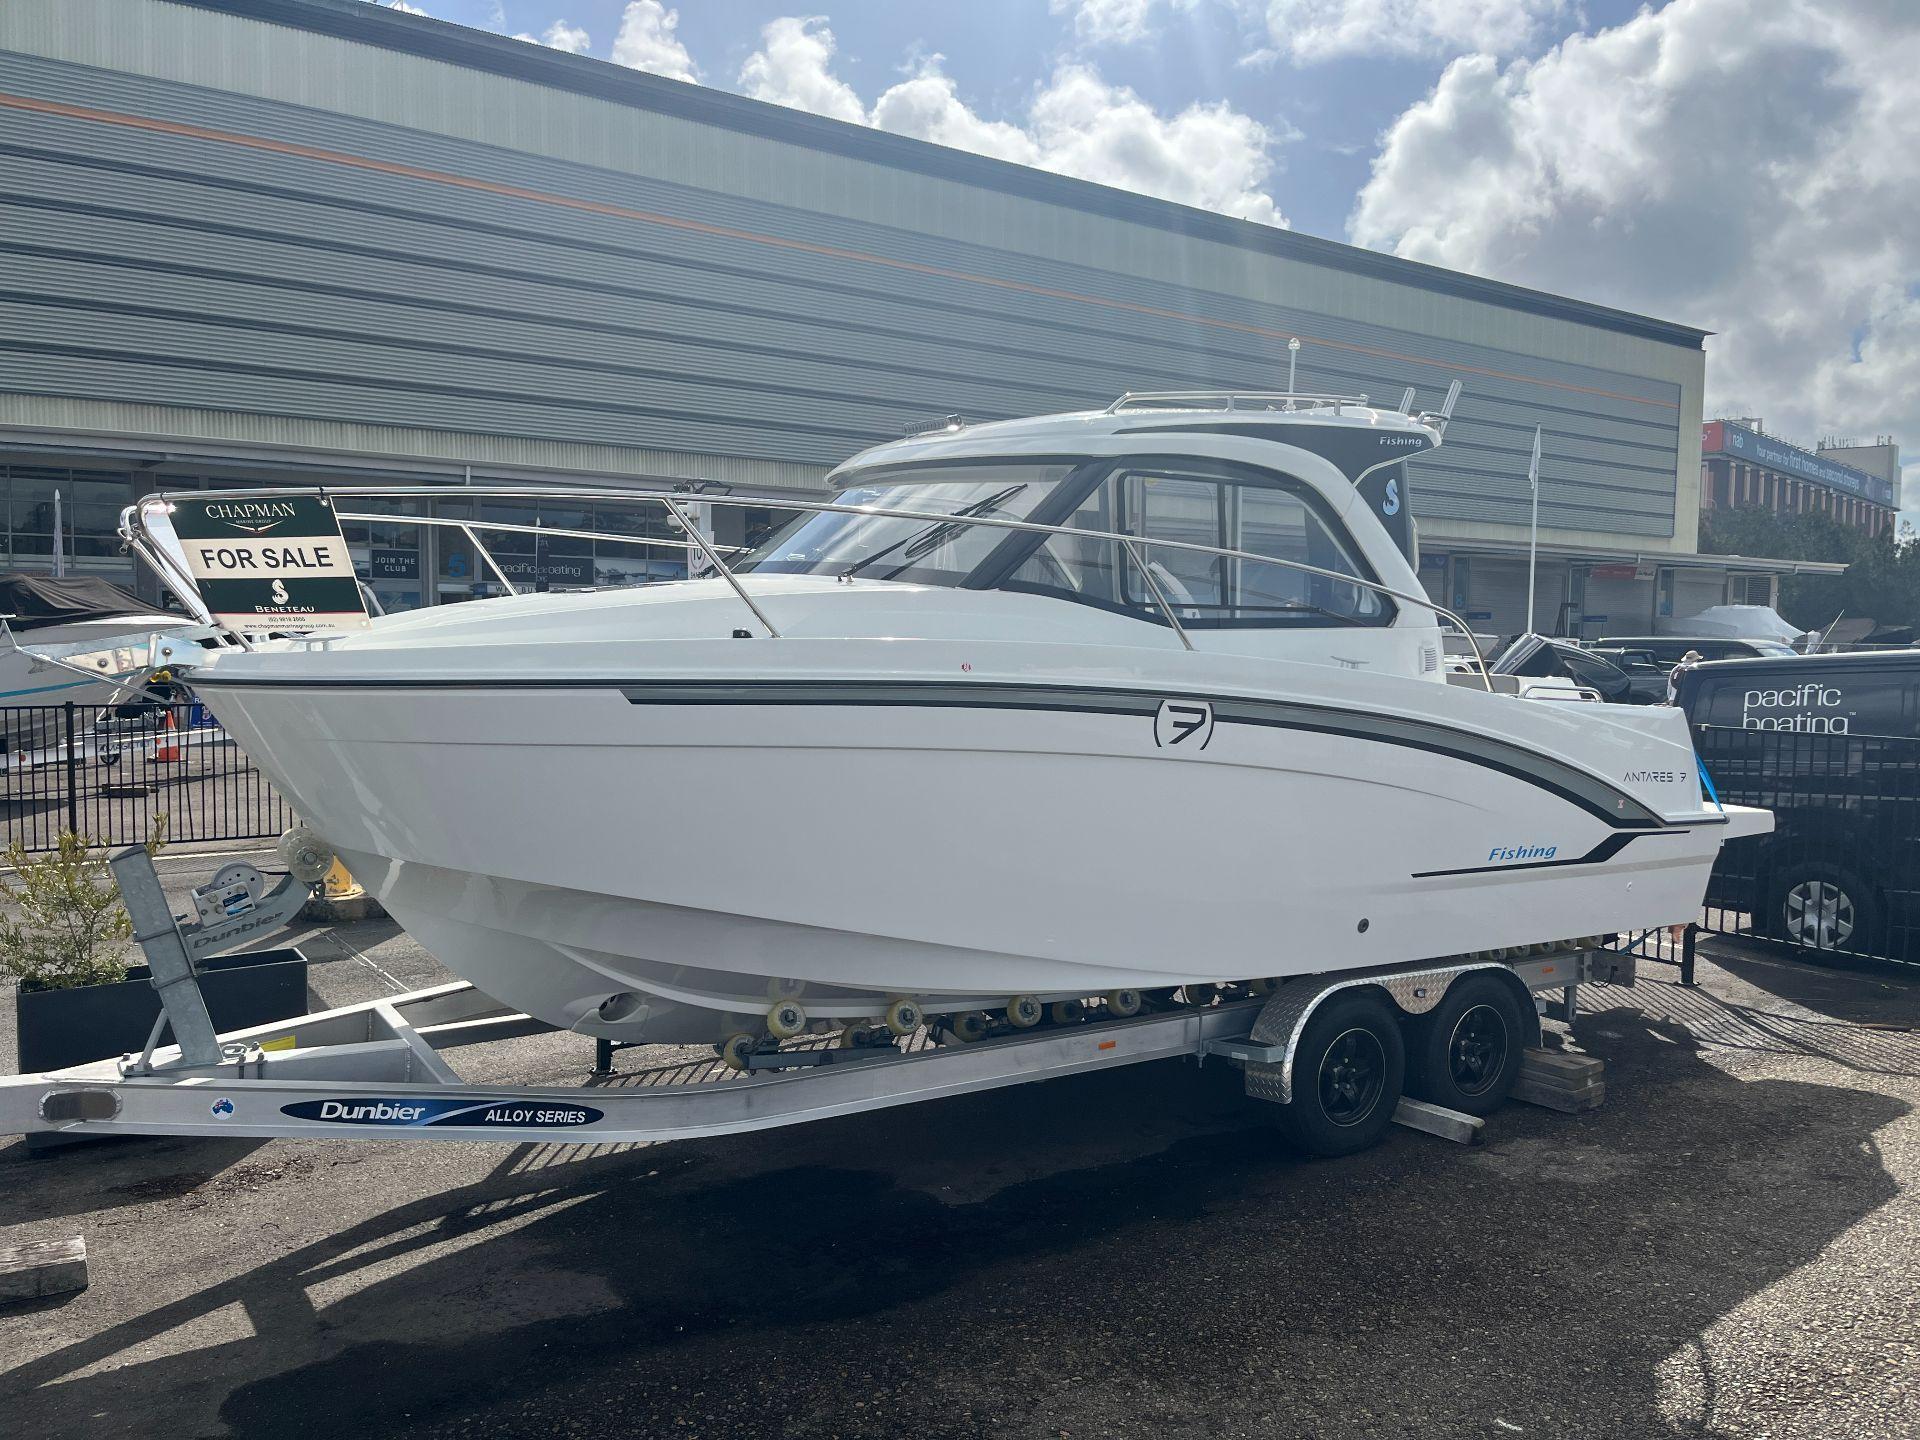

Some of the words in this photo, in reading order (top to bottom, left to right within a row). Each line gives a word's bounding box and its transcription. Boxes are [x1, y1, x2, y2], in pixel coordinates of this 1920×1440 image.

[1380, 436, 1422, 447] Fishing
[1732, 433, 1744, 449] nab
[1790, 450, 1801, 470] first
[1802, 455, 1818, 476] homes
[205, 503, 296, 519] CHAPMAN
[200, 548, 258, 569] FOR
[261, 547, 334, 568] SALE
[448, 553, 465, 577] 5
[254, 605, 315, 613] BENETEAU
[1743, 683, 1842, 712] pacific
[1623, 771, 1673, 782] ANTARES
[1680, 772, 1687, 782] 7
[1488, 845, 1558, 861] Fishing
[193, 911, 284, 949] Dunbier
[320, 1101, 426, 1120] Dunbier
[484, 1109, 534, 1122] ALLOY
[535, 1110, 586, 1123] SERIES
